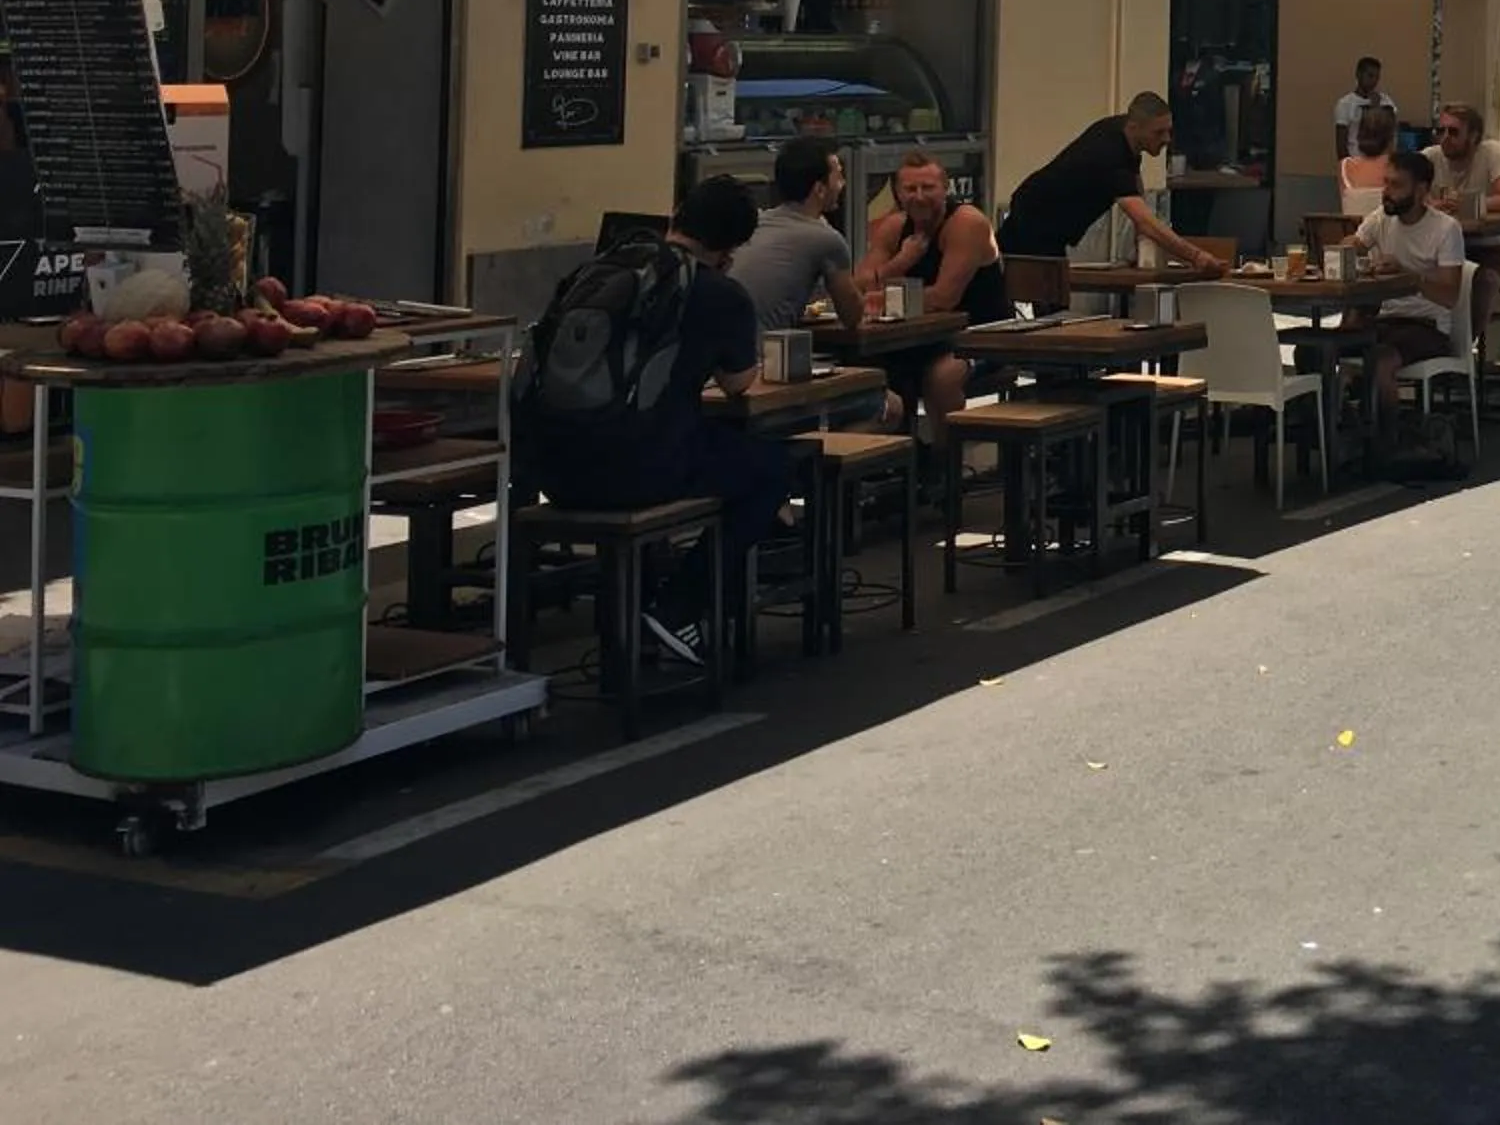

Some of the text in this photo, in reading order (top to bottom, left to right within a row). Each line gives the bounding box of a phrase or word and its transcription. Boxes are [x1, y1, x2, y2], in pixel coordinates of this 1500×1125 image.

[540, 13, 615, 26] GASTRONOMIA
[549, 31, 604, 44] PANINERIA
[553, 49, 601, 62] WINE BAR
[543, 67, 609, 80] LOUNGE BAR
[34, 253, 86, 276] APE
